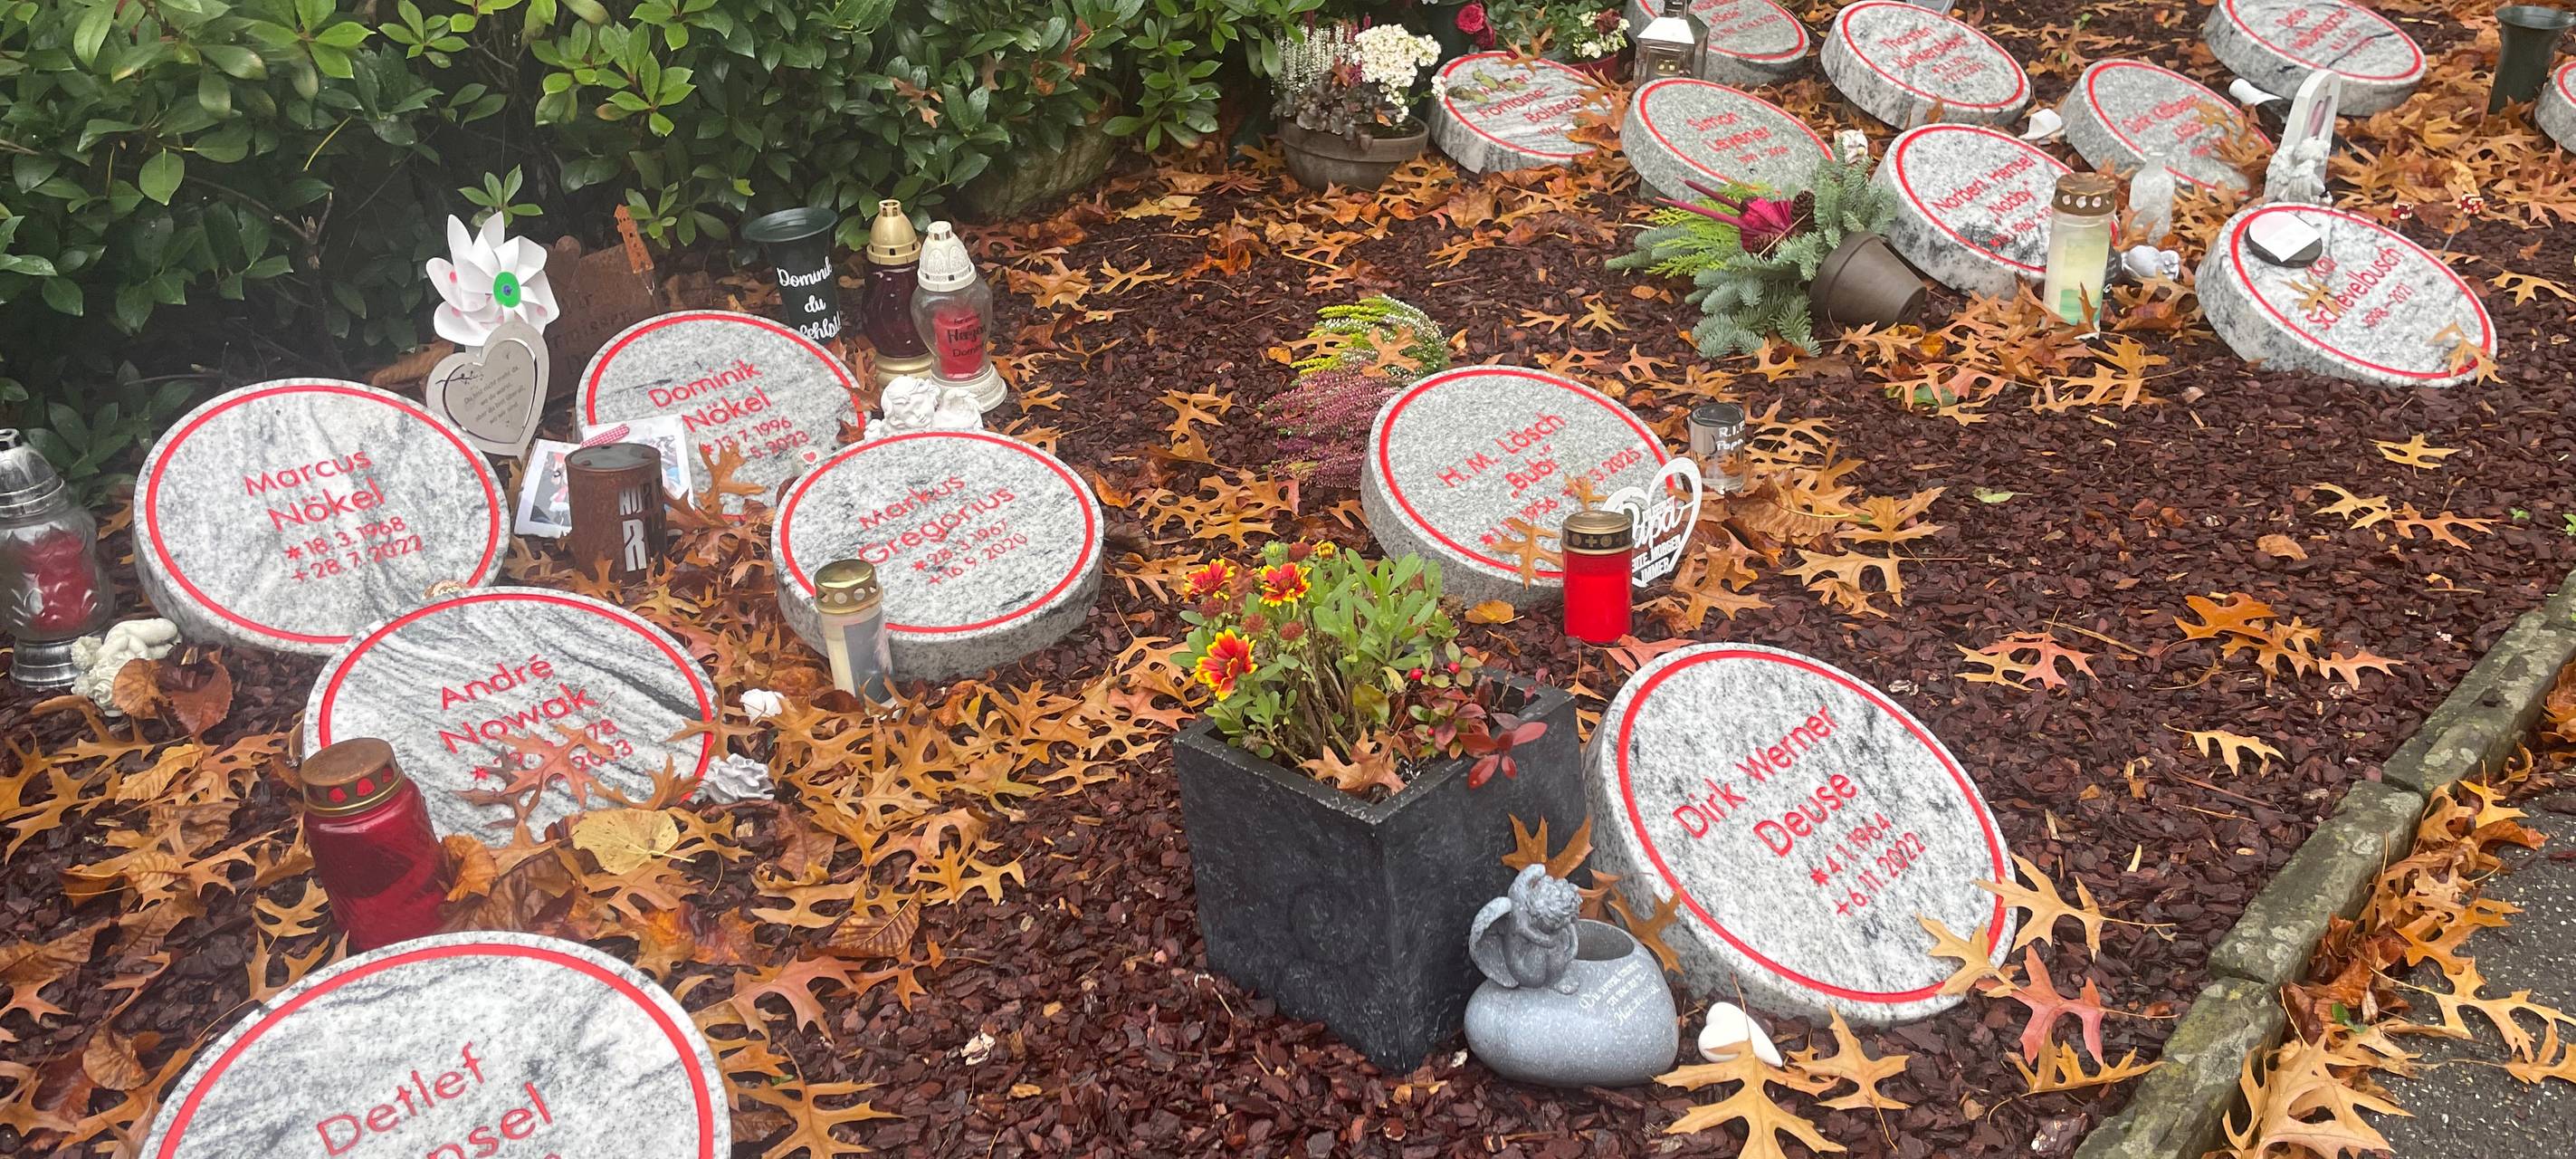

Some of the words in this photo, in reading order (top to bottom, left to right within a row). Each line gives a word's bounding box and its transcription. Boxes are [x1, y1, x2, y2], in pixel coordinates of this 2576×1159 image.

[1686, 111, 1742, 132] Simon
[1930, 174, 1990, 214] Norbert
[1985, 150, 2037, 184] Hensel
[776, 255, 833, 287] Dominik
[804, 294, 826, 313] du
[647, 359, 763, 407] Dominik
[681, 385, 772, 433] Nökel
[243, 450, 373, 497] Marcus
[1436, 466, 1472, 488] H.
[1465, 451, 1501, 475] M.
[1494, 411, 1566, 455] Lösch
[267, 476, 386, 533] Nökel
[858, 473, 966, 531] Markus
[858, 487, 1016, 565] Gregorius
[441, 653, 554, 711] André
[438, 682, 599, 754] Nowak
[1672, 777, 1747, 839] Dirk
[1734, 704, 1838, 783] Werner
[1752, 773, 1858, 858] Deuse
[317, 1040, 486, 1156] Detlef
